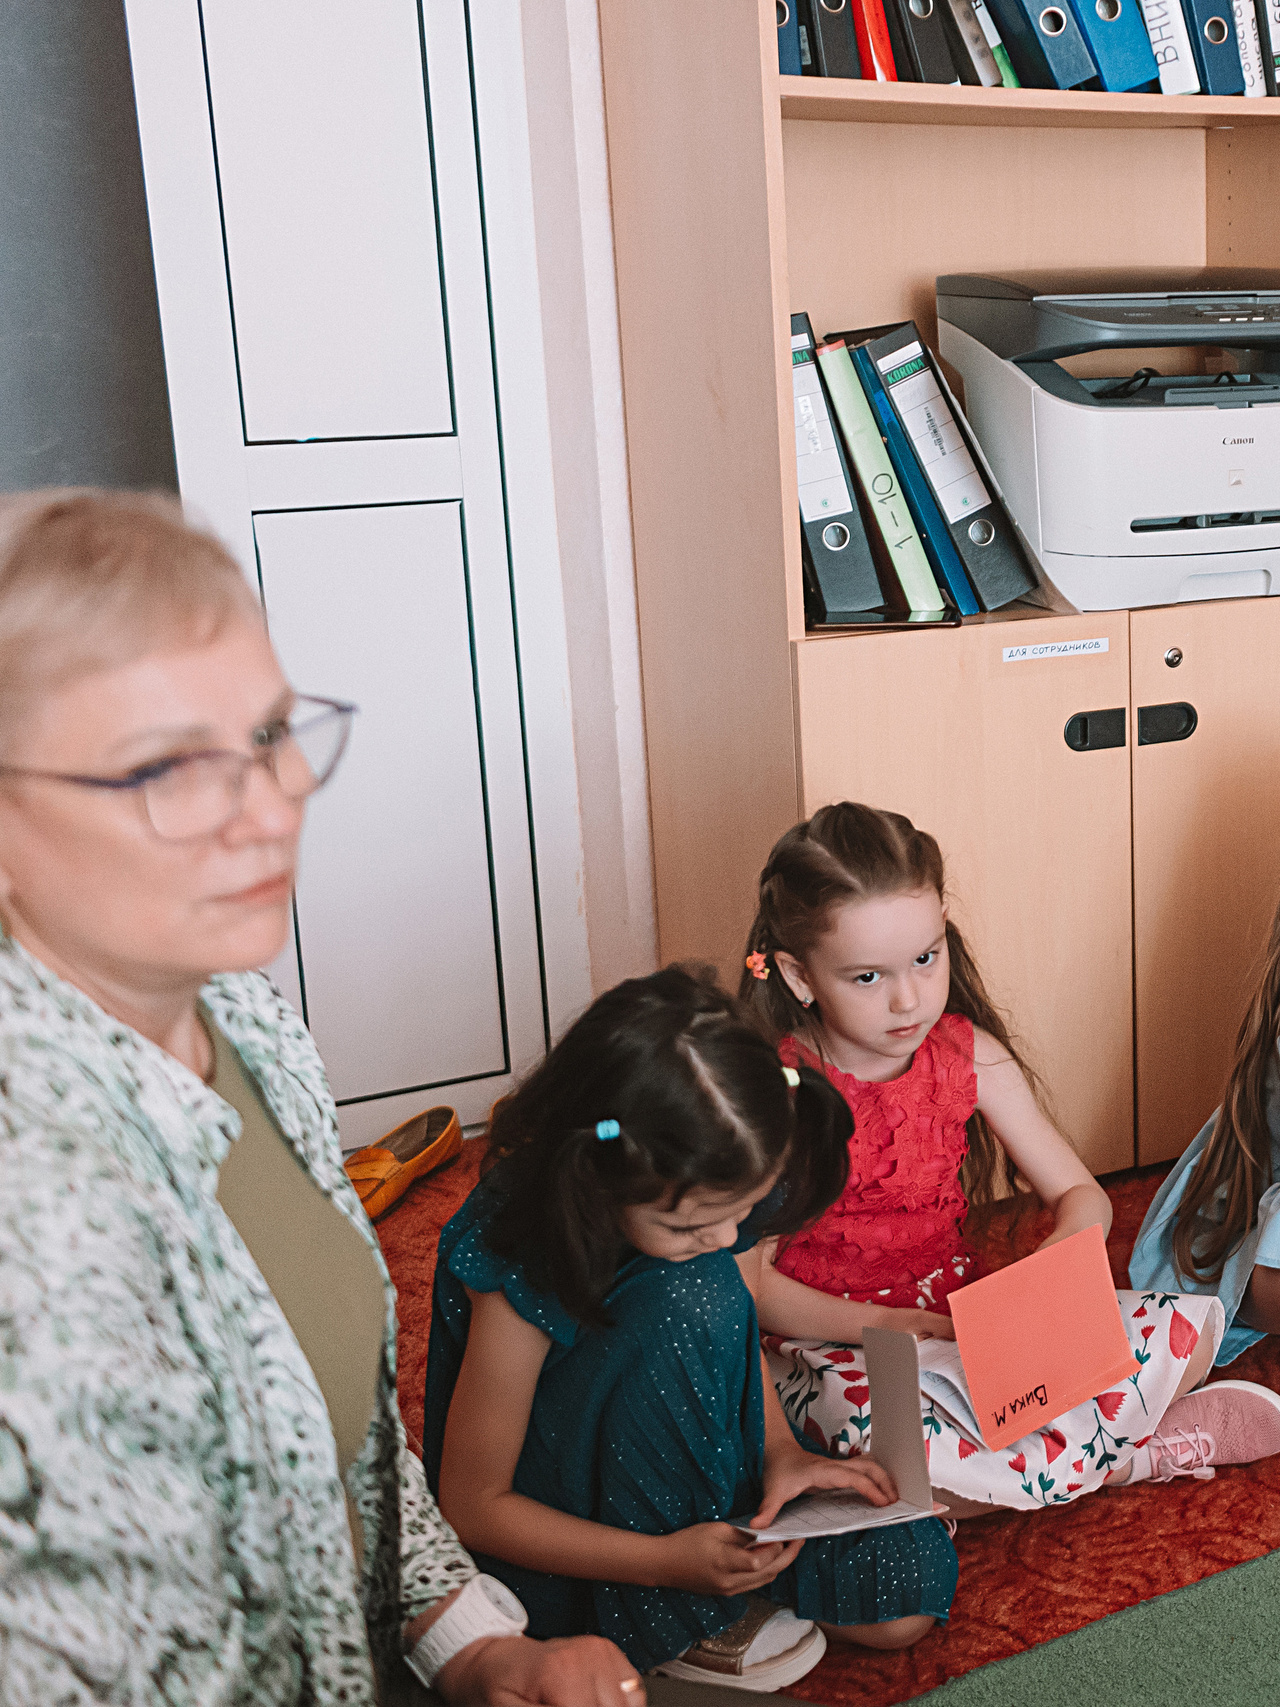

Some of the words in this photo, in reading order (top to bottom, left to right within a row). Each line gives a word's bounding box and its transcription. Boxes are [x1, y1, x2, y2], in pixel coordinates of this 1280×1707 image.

[1144, 0, 1179, 66] ВНИ
[1234, 0, 1255, 88] Сопоста
[886, 357, 926, 384] KORONA
[1222, 436, 1255, 446] Canon
[1008, 647, 1027, 658] ДЛЯ
[1032, 641, 1101, 654] СОТРУДНИКОВ
